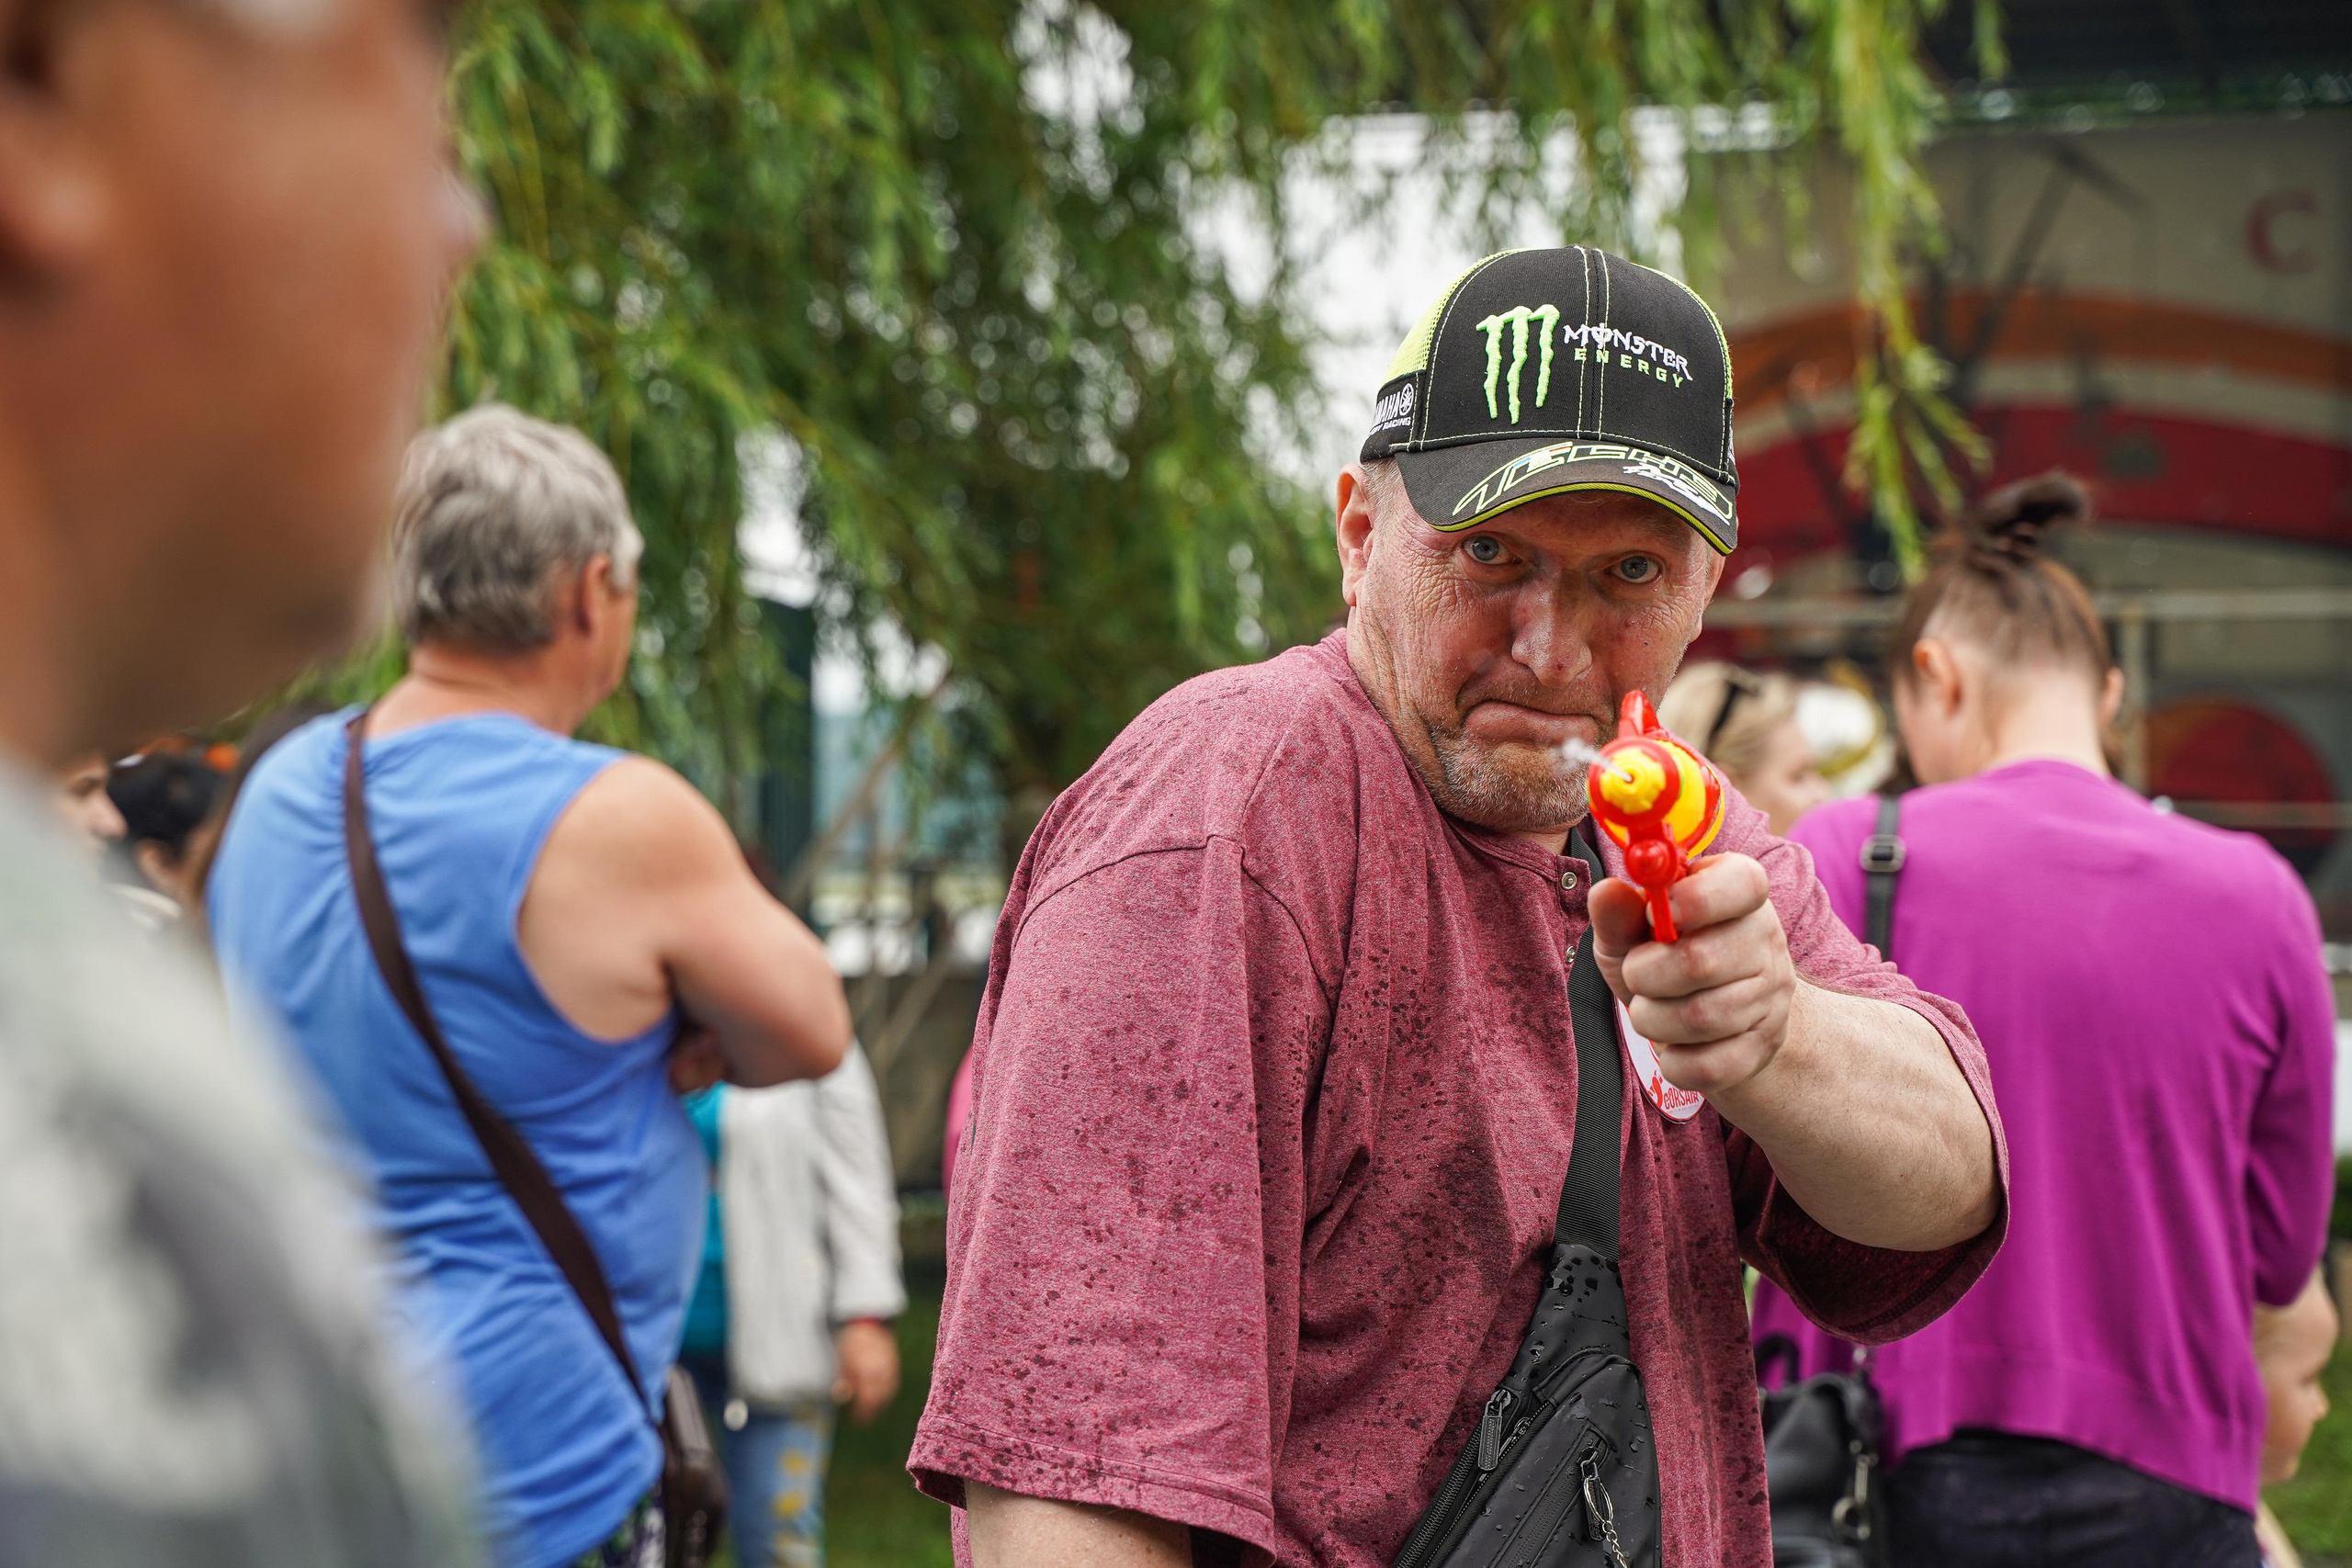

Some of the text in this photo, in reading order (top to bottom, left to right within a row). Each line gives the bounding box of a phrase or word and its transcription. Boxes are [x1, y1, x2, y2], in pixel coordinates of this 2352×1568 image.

[1563, 322, 1693, 381] MONSTER
[1574, 347, 1684, 389] ENERGY
[1383, 416, 1411, 431] RACING
[1664, 1087, 1700, 1110] CORSAIR
